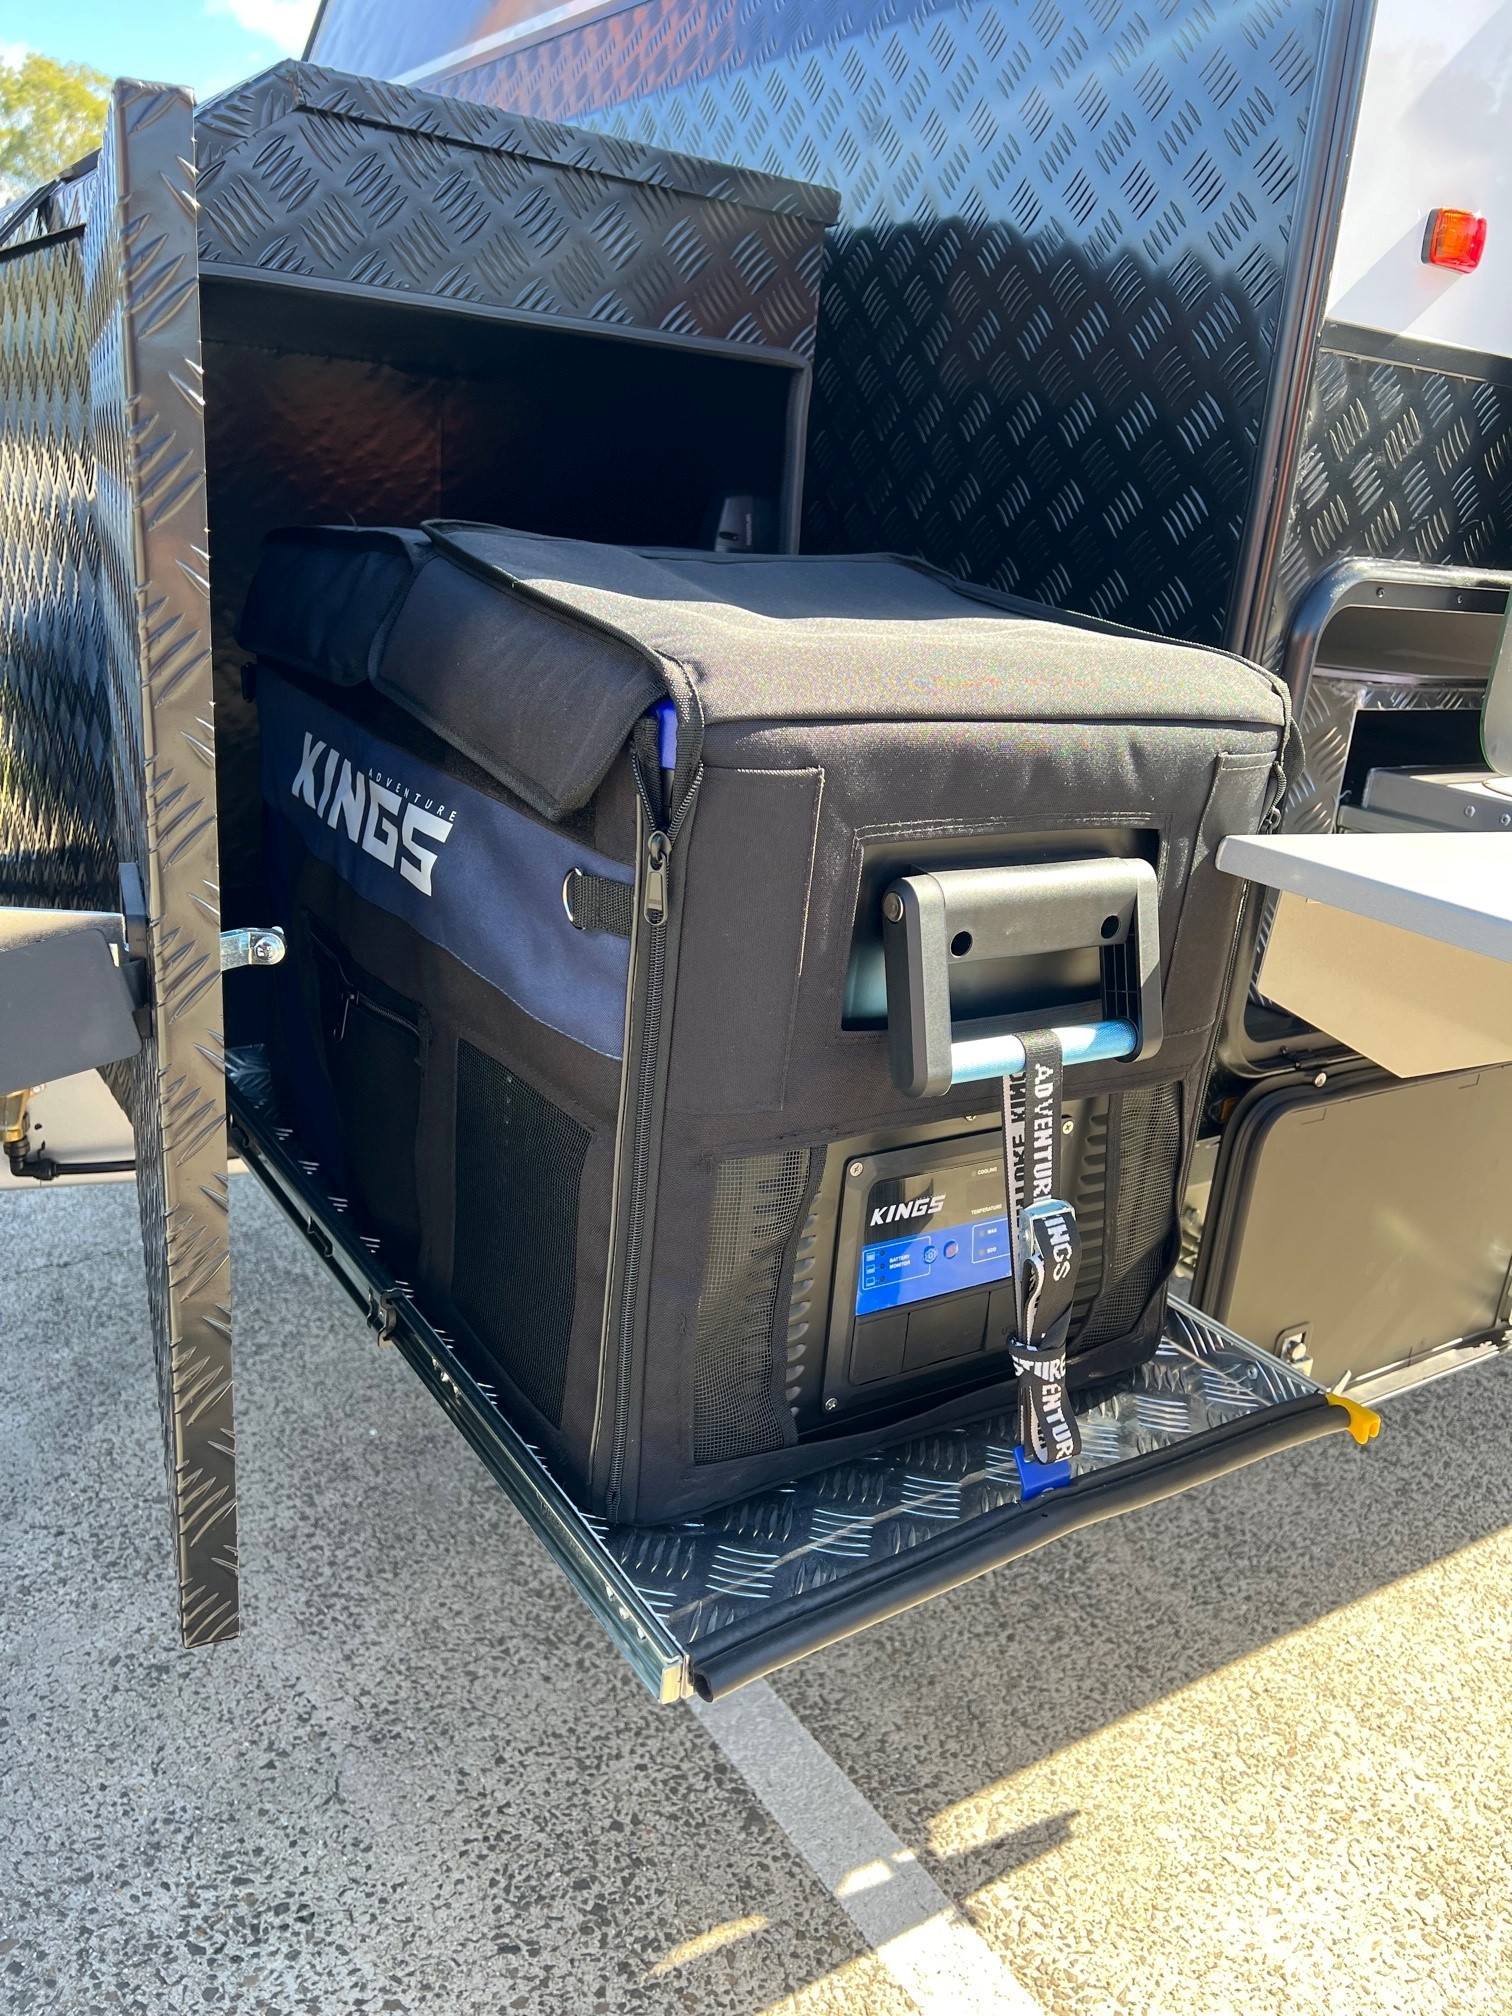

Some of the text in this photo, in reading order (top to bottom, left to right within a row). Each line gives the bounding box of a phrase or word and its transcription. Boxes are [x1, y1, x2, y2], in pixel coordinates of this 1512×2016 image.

[368, 768, 457, 822] ADVENTURE
[291, 731, 453, 897] KINGS
[977, 1166, 998, 1176] COOLING
[869, 1194, 946, 1227] KINGS
[970, 1203, 1003, 1216] TEMPERATURE
[889, 1254, 911, 1264] BATTERY
[1042, 1214, 1073, 1281] INGS
[889, 1260, 911, 1270] MONITOR
